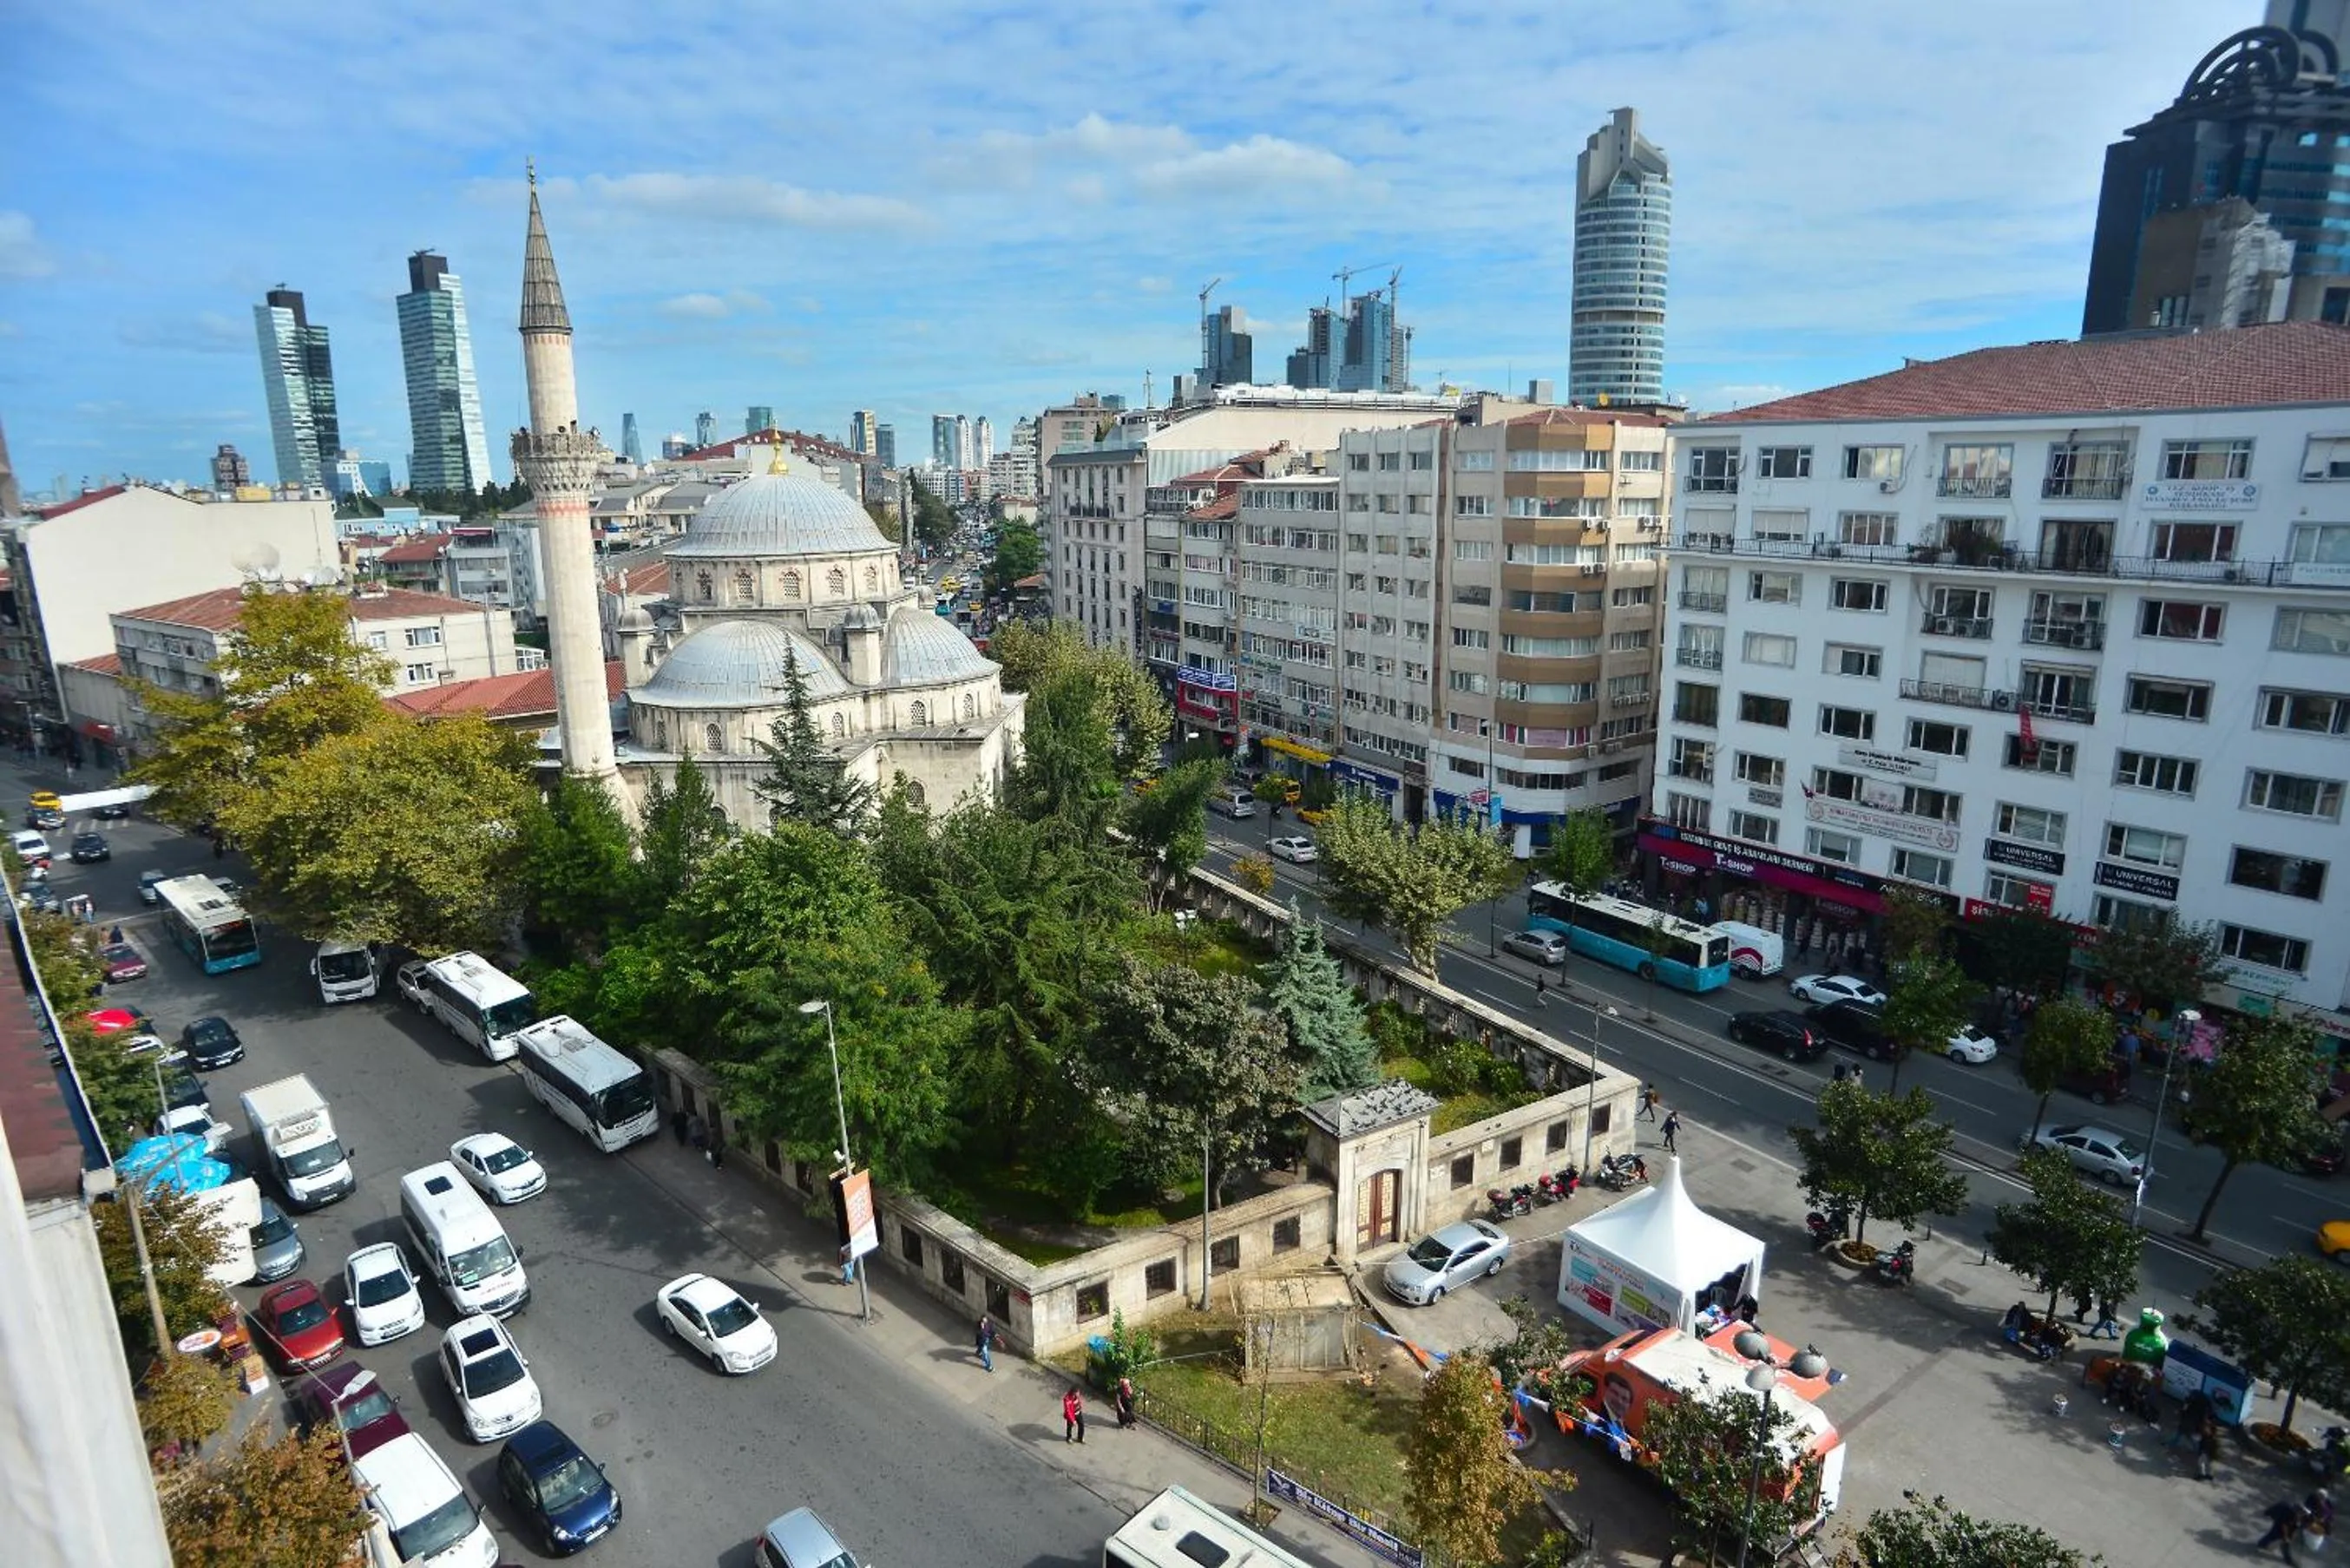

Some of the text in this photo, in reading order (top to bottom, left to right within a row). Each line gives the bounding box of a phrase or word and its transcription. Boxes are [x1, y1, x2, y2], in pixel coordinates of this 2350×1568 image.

[1714, 852, 1755, 874] T-SHOP
[2005, 846, 2055, 863] UNIVERSAL
[1659, 856, 1697, 874] T-SHOP
[2115, 869, 2175, 888] UNIVERSAL
